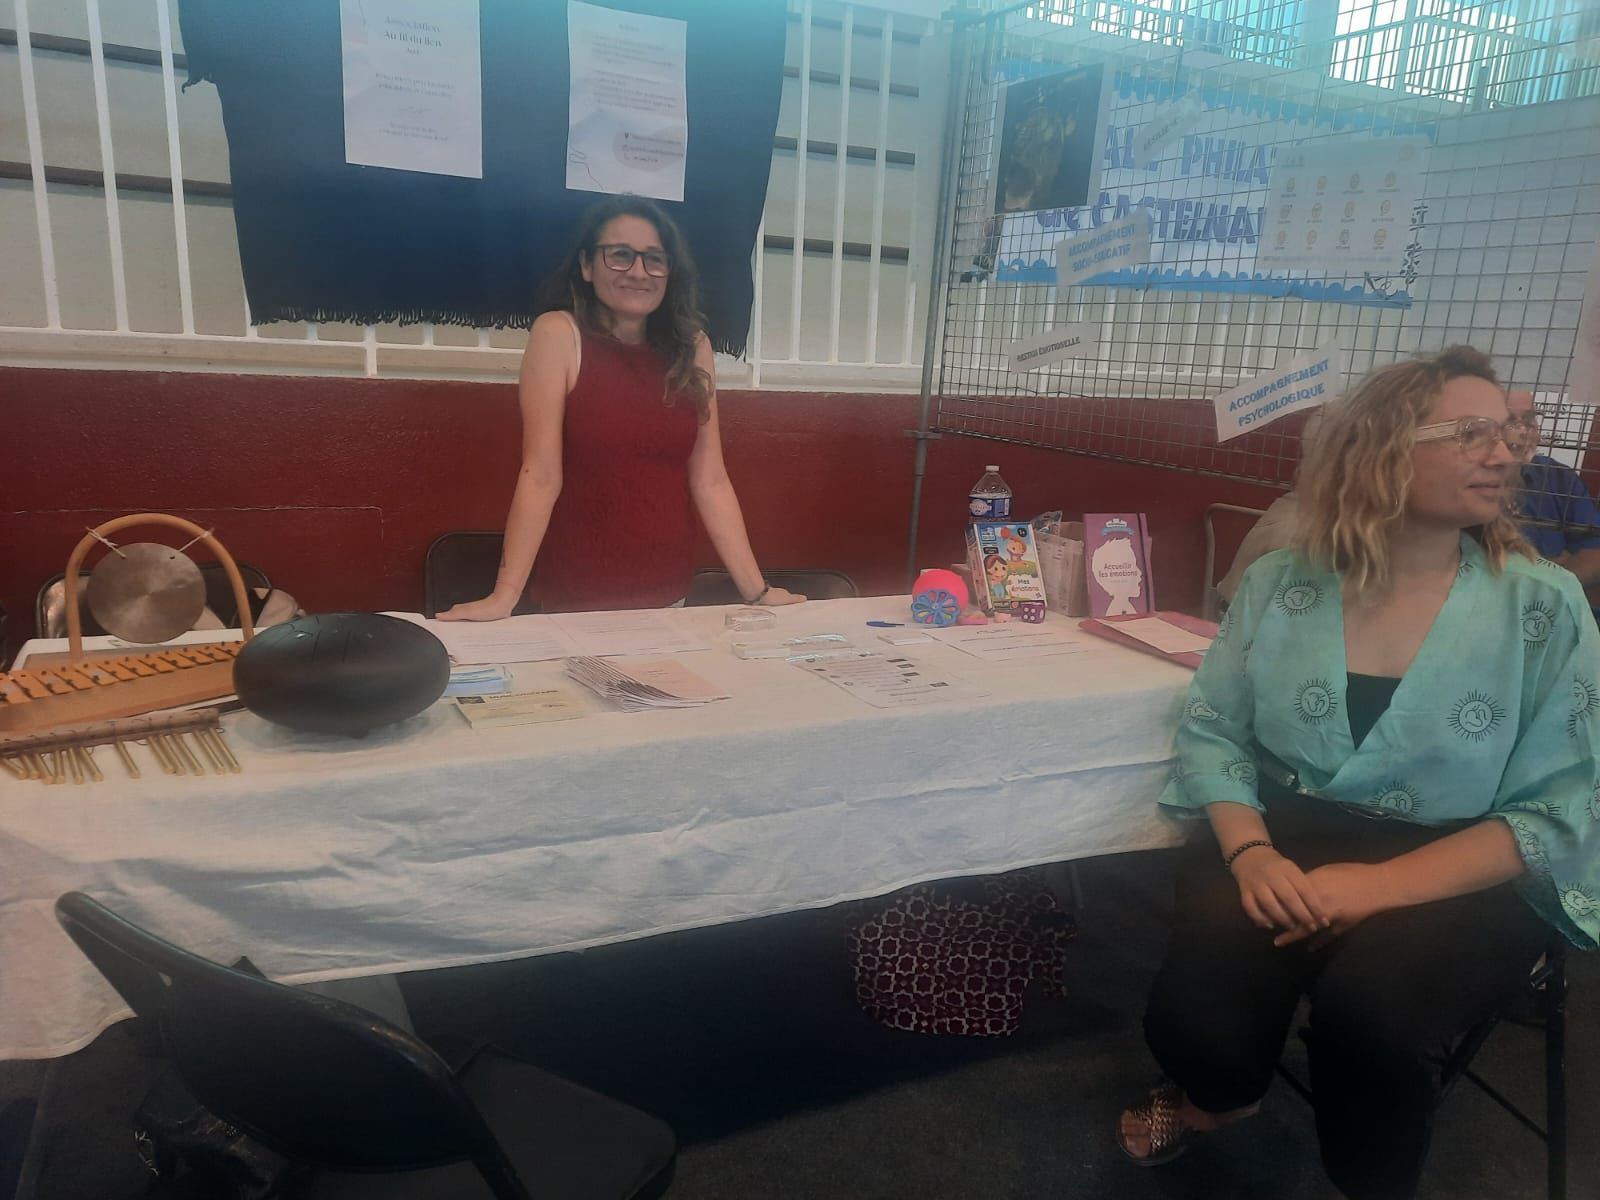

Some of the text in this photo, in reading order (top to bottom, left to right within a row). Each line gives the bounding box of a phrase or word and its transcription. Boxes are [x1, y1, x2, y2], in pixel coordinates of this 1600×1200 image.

[1229, 358, 1328, 412] ACCOMPAGNEMENT
[1237, 381, 1325, 427] PSYCHOLOGIQUE
[1098, 570, 1109, 578] les
